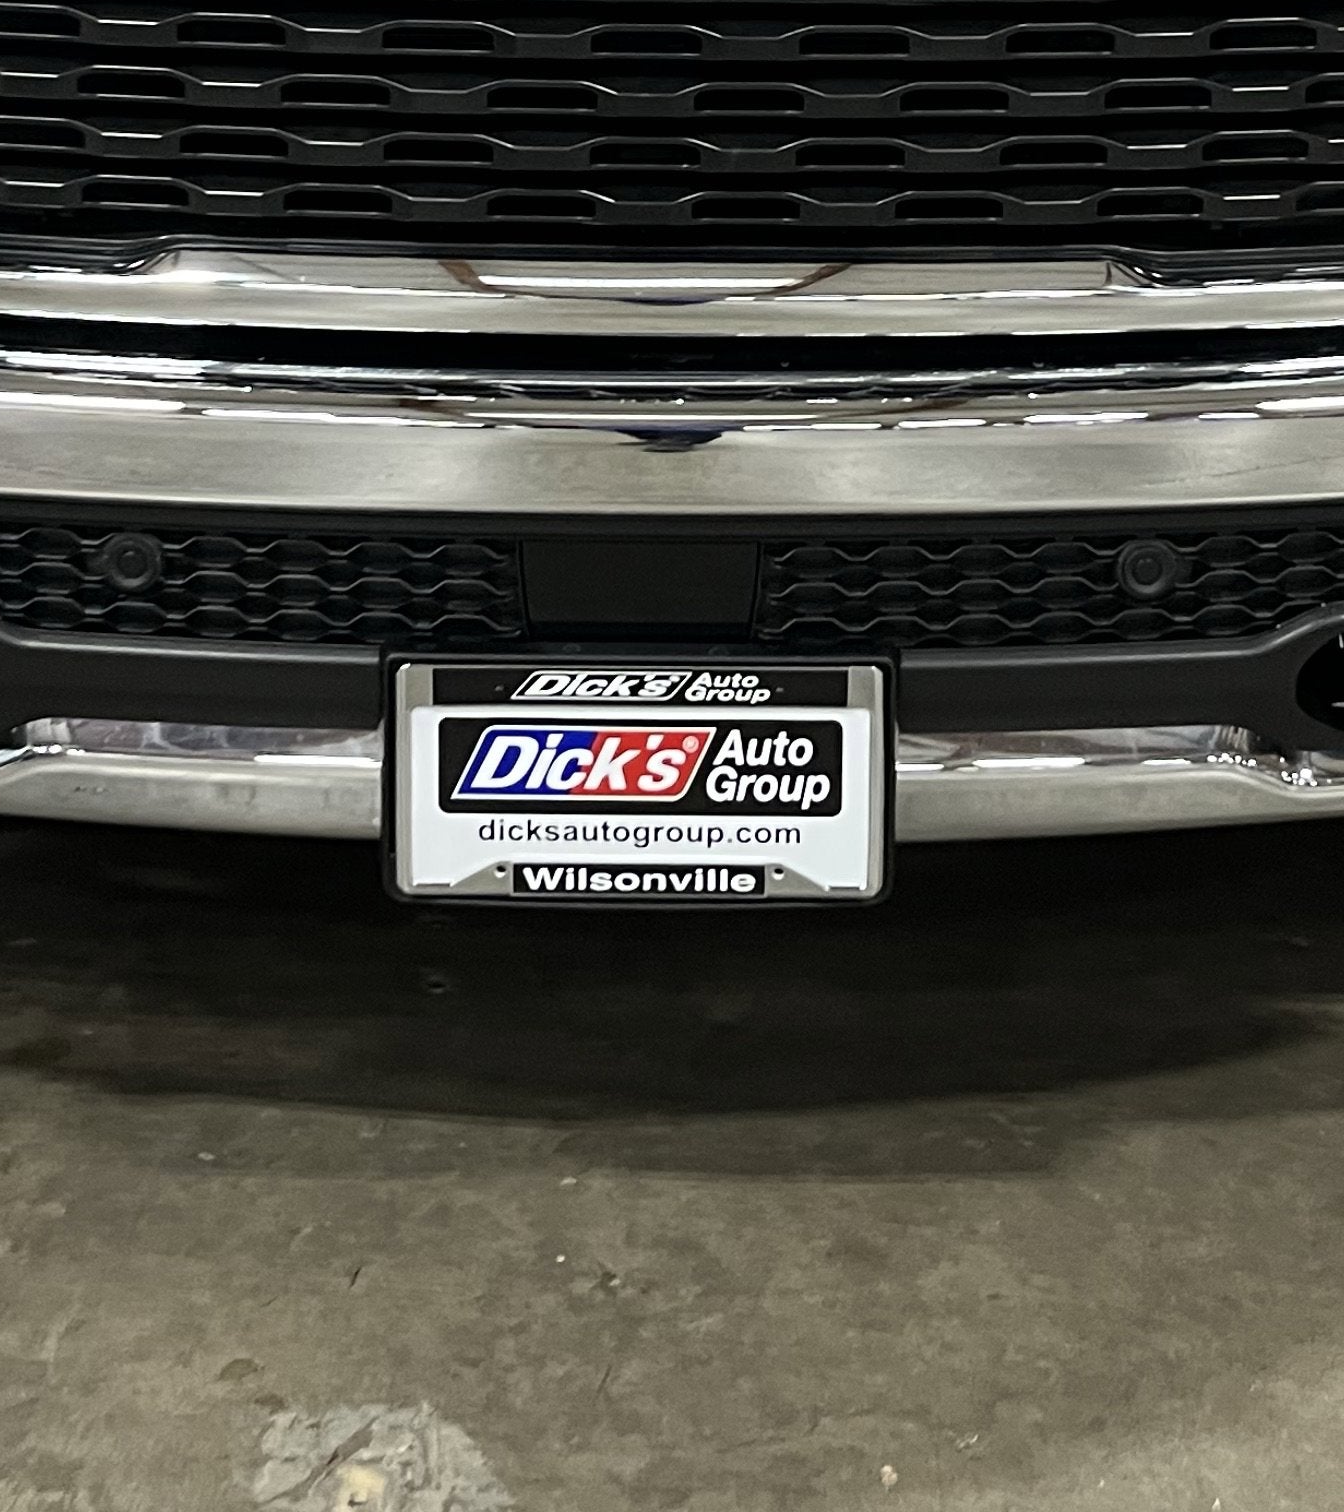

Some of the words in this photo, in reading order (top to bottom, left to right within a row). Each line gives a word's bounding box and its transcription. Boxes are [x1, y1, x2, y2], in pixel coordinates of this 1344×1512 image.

[689, 672, 760, 688] Auto
[684, 687, 771, 704] Group
[470, 732, 686, 791] Dick's
[712, 728, 814, 767] Auto
[706, 766, 831, 811] Group
[478, 819, 802, 847] dicksautogroup.com
[522, 866, 757, 893] Wilsonville
